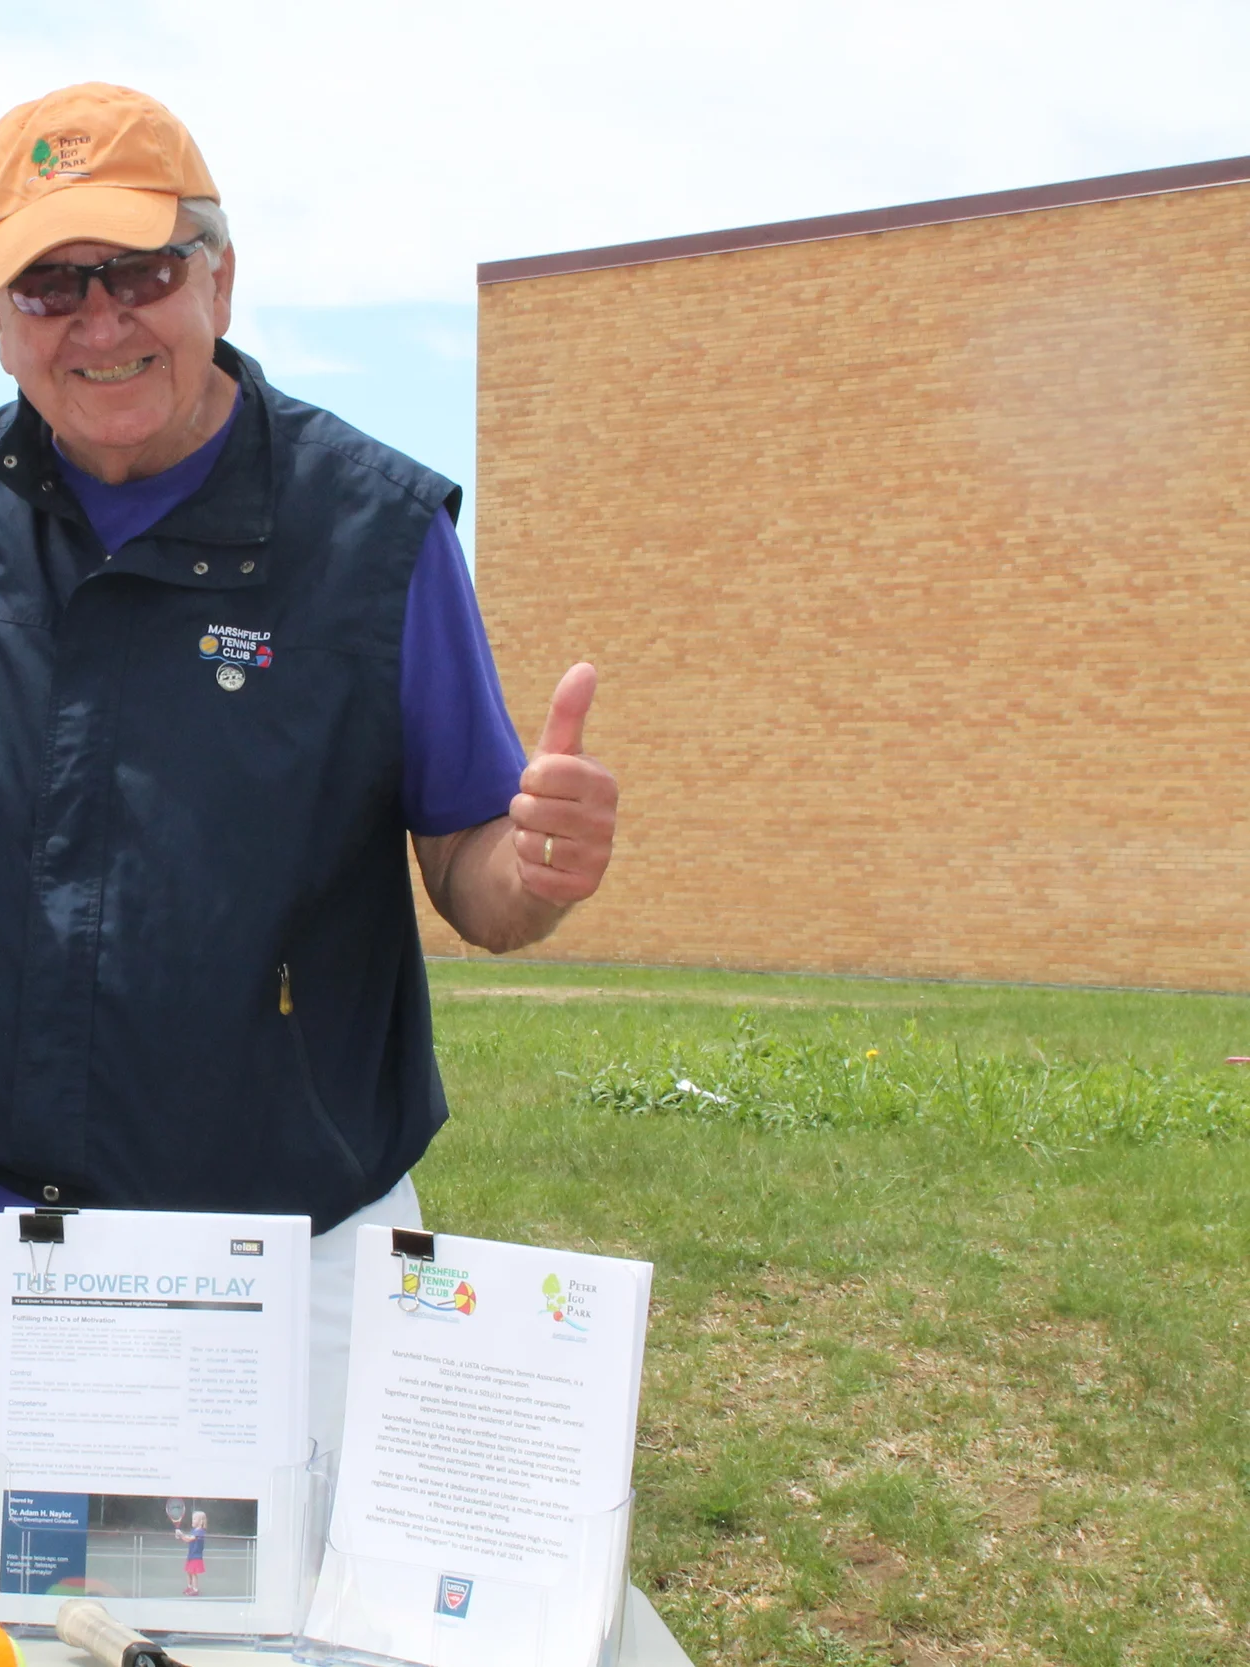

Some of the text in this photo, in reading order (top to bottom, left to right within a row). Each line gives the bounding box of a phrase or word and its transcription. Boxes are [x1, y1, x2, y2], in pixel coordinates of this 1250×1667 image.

[59, 135, 91, 148] PETER
[60, 158, 87, 169] PARK
[208, 624, 271, 641] MARSHFIELD
[220, 636, 257, 651] TENNIS
[222, 648, 250, 660] CLUB
[408, 1263, 469, 1279] MARSHFIELD
[13, 1272, 256, 1297] THE POWER OF PLAY
[421, 1276, 455, 1289] TENNIS
[569, 1280, 597, 1293] PETER
[425, 1287, 449, 1298] CLUB
[12, 1314, 41, 1323] Fulfilling
[80, 1315, 116, 1323] Motivation
[566, 1305, 592, 1319] PARK
[391, 1349, 422, 1360] Marshfield
[422, 1354, 441, 1364] Tennis
[441, 1357, 455, 1366] Club
[463, 1361, 479, 1369] USTA
[480, 1363, 514, 1376] Community
[515, 1369, 535, 1378] Tennis
[398, 1375, 419, 1385] Friends
[427, 1380, 443, 1388] Peter
[443, 1383, 453, 1392] Igo
[453, 1384, 467, 1393] Park
[501, 1394, 532, 1404] non-profit
[533, 1399, 570, 1410] organization
[7, 1398, 47, 1407] Competence
[384, 1387, 409, 1398] Together
[419, 1395, 440, 1404] groups
[440, 1397, 458, 1406] blend
[458, 1400, 477, 1410] tennis
[477, 1404, 491, 1412] with
[491, 1407, 512, 1416] overall
[512, 1409, 533, 1419] fitness
[546, 1415, 561, 1424] offer
[49, 1510, 72, 1519] Naylor
[375, 1504, 405, 1516] Marshfield
[406, 1510, 424, 1521] Tennis
[425, 1514, 439, 1523] Club
[445, 1519, 469, 1530] working
[469, 1523, 484, 1531] with
[483, 1525, 494, 1534] the
[494, 1527, 526, 1540] Marshfield
[527, 1533, 541, 1544] High
[541, 1537, 562, 1547] School
